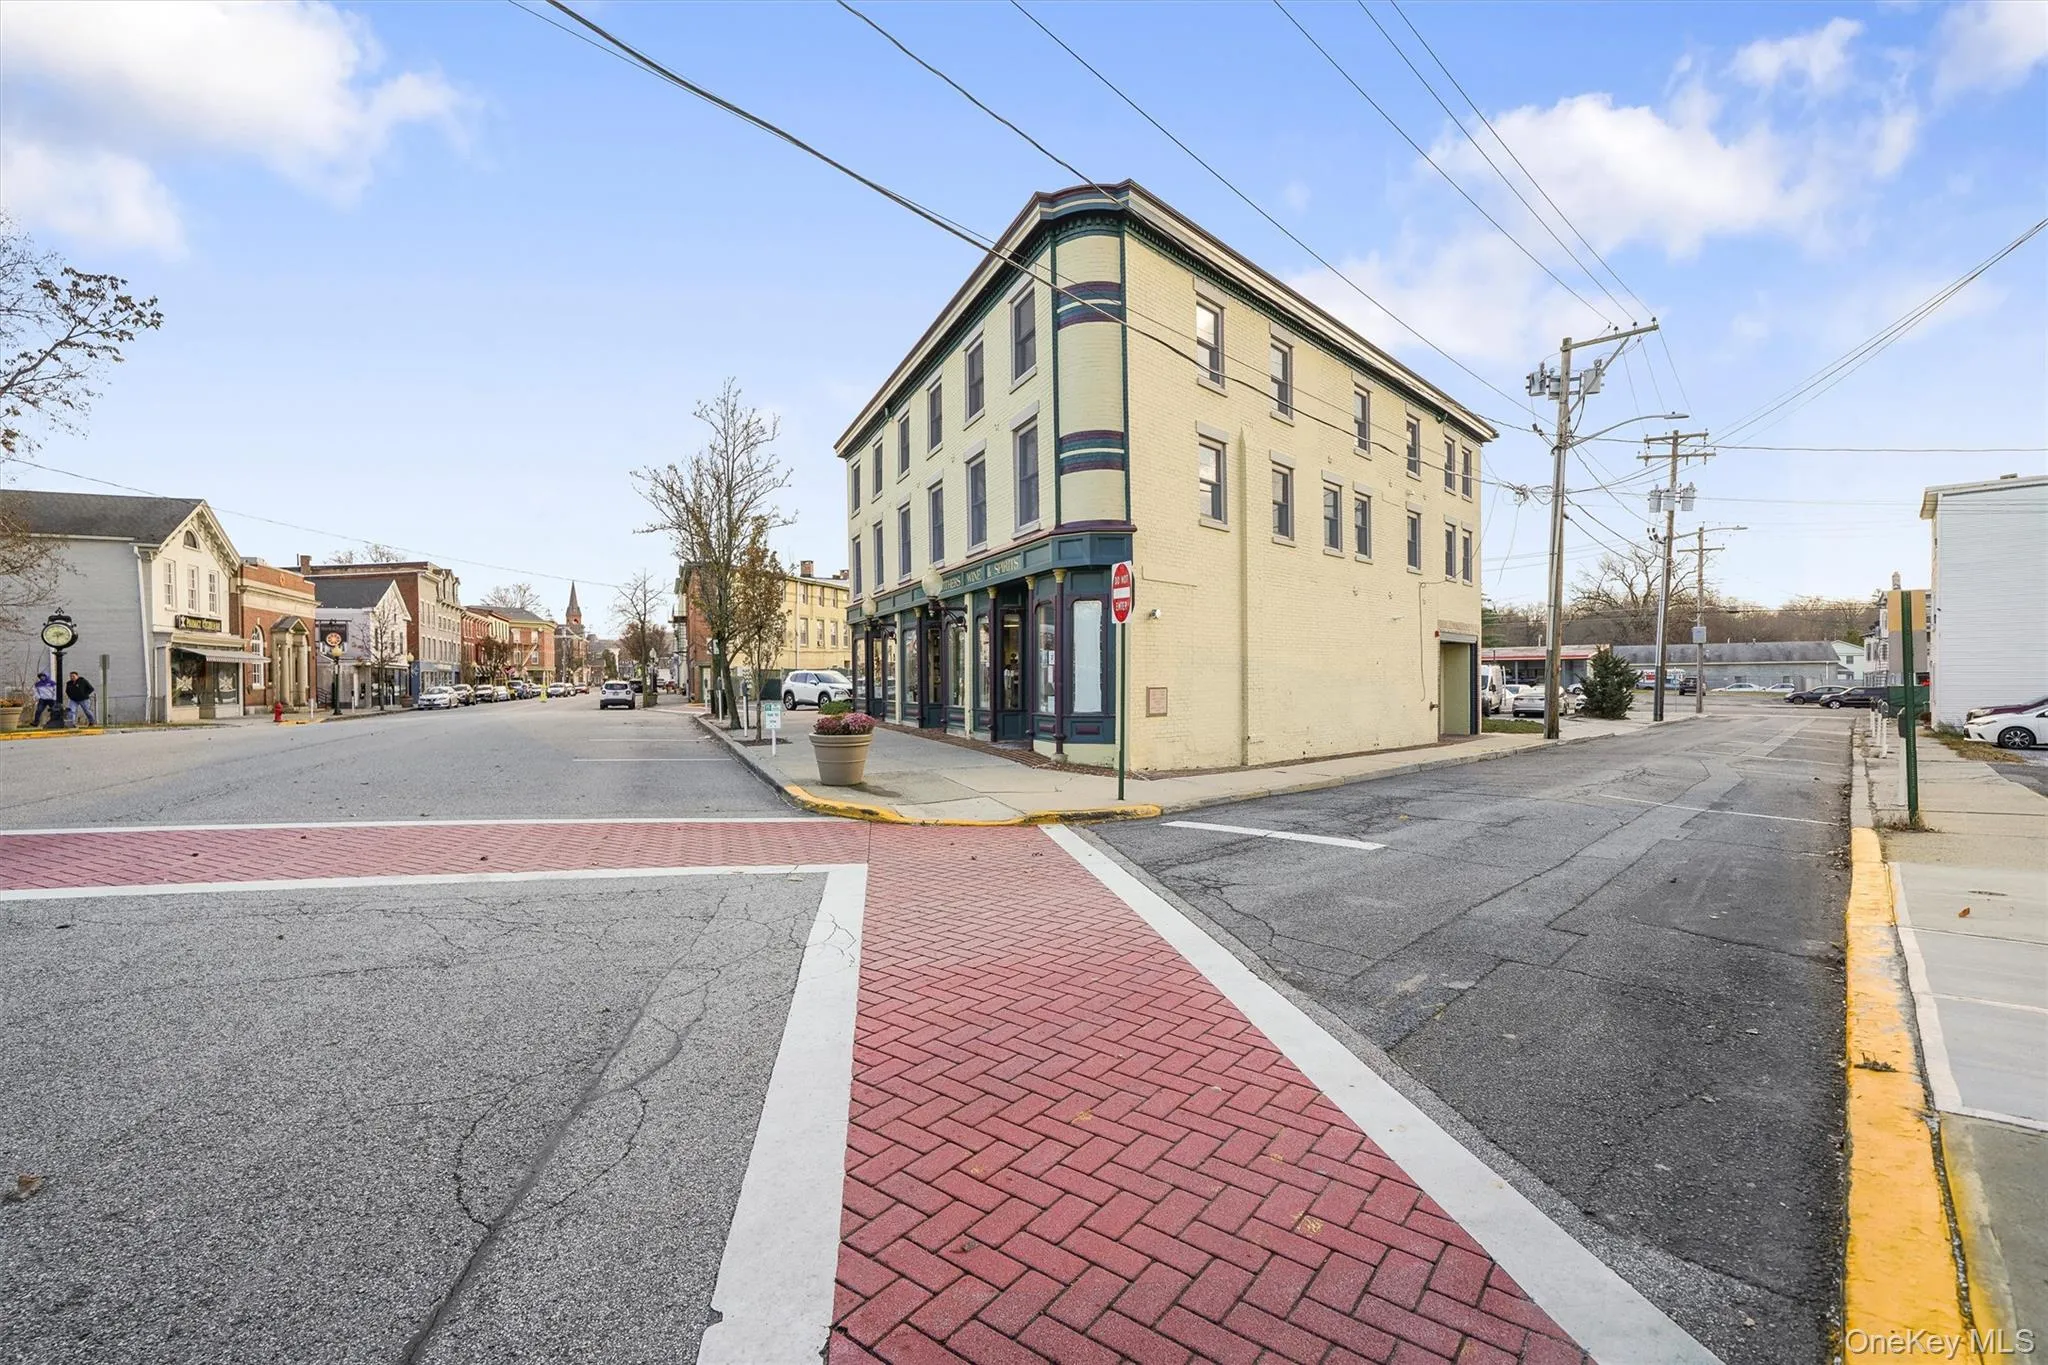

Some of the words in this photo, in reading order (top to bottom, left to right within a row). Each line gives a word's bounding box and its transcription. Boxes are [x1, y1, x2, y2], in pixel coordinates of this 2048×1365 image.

[966, 568, 982, 582] WINE
[994, 558, 1019, 574] SPIRITS
[1114, 575, 1120, 585] DO
[1121, 574, 1129, 584] NOT
[1115, 600, 1129, 611] ENTER
